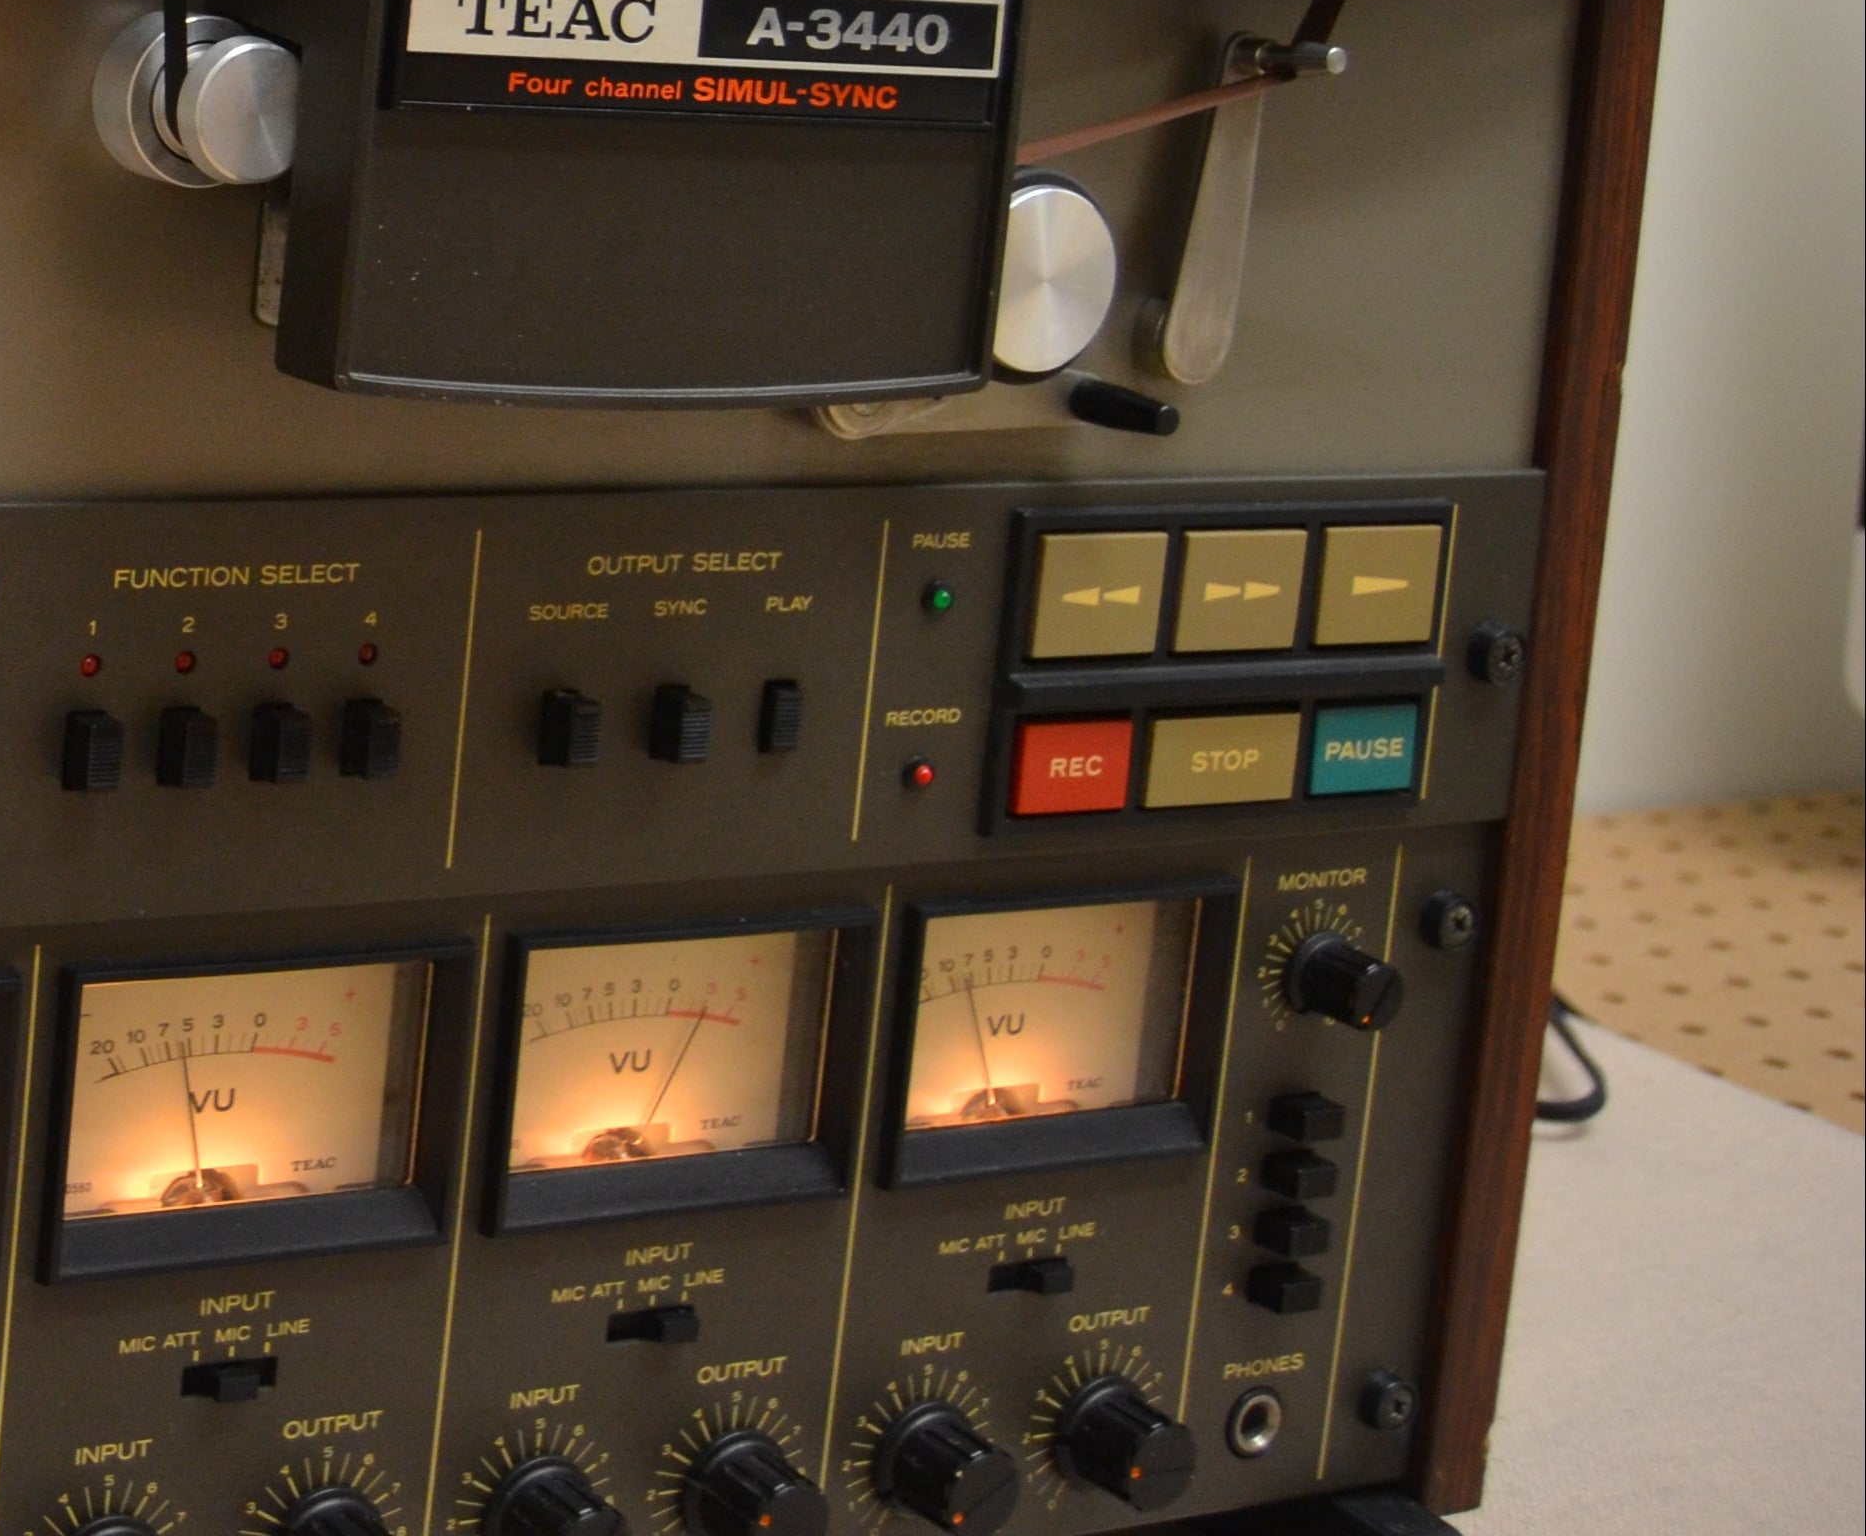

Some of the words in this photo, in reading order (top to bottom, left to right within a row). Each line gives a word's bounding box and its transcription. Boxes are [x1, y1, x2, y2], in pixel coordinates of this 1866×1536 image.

[746, 7, 950, 55] A-3440
[508, 71, 573, 96] Four
[584, 76, 682, 102] channel
[693, 75, 898, 110] SIMUL-SYNC
[912, 532, 970, 549] PAUSE
[113, 565, 251, 589] FUNCTION
[260, 562, 361, 584] SELECT
[586, 554, 683, 577] OUTPUT
[691, 552, 783, 573] SELECT
[529, 601, 609, 622] SOURCE
[654, 599, 708, 617] SYNC
[764, 595, 813, 612] PLAY
[88, 620, 97, 636] 1
[181, 616, 195, 634] 2
[274, 613, 288, 630] 3
[364, 612, 378, 627] 4
[885, 707, 961, 726] RECORD
[1191, 749, 1259, 772] STOP
[1324, 738, 1405, 761] PAUSE
[1049, 756, 1103, 778] REC
[1277, 867, 1368, 892] MONITOR
[582, 987, 593, 1000] 7
[632, 980, 643, 993] 3
[668, 978, 680, 992] 0
[90, 1040, 115, 1054] 20
[127, 1029, 145, 1044] 10
[158, 1023, 169, 1037] 7
[182, 1017, 194, 1032] 5
[213, 1014, 224, 1029] 3
[254, 1013, 266, 1027] 0
[987, 1013, 1025, 1037] VU
[610, 1048, 652, 1074] VU
[1066, 1077, 1102, 1091] TEAC
[188, 1088, 235, 1114] VU
[700, 1116, 742, 1130] TEAC
[291, 1156, 336, 1172] TEAC
[1237, 1169, 1247, 1182] 2
[1004, 1196, 1067, 1221] INPUT
[938, 1238, 970, 1255] MIC
[975, 1233, 1006, 1251] ATT
[1016, 1228, 1047, 1246] MIC
[1058, 1222, 1097, 1240] LINE
[1229, 1225, 1240, 1240] 3
[624, 1242, 695, 1267] INPUT
[551, 1286, 585, 1304] MIC
[590, 1281, 626, 1298] ATT
[637, 1276, 671, 1294] MIC
[684, 1269, 725, 1288] LINE
[200, 1290, 276, 1316] INPUT
[1068, 1306, 1151, 1333] OUTPUT
[118, 1336, 156, 1355] MIC
[163, 1331, 201, 1349] ATT
[215, 1326, 252, 1344] MIC
[266, 1319, 311, 1337] LINE
[900, 1331, 965, 1356] INPUT
[697, 1356, 787, 1385] OUTPUT
[1223, 1353, 1305, 1380] PHONES
[509, 1384, 581, 1410] INPUT
[282, 1410, 384, 1440] OUTPUT
[842, 1458, 853, 1471] 2
[856, 1415, 867, 1428] 3
[924, 1364, 934, 1376] 5
[1022, 1432, 1032, 1445] 2
[1036, 1388, 1047, 1401] 3
[75, 1439, 153, 1466] INPUT
[646, 1488, 657, 1501] 2
[661, 1444, 673, 1456] 3
[692, 1409, 703, 1419] 4
[732, 1390, 742, 1402] 5
[246, 1502, 257, 1512] 3
[279, 1465, 290, 1476] 4
[323, 1446, 333, 1458] 5
[363, 1454, 375, 1465] 6
[446, 1519, 457, 1531] 2
[462, 1472, 473, 1484] 3
[494, 1436, 505, 1447] 4
[536, 1418, 546, 1429] 5
[573, 1424, 585, 1437] 6
[58, 1494, 69, 1504] 4
[104, 1474, 114, 1486] 5
[146, 1482, 158, 1494] 6
